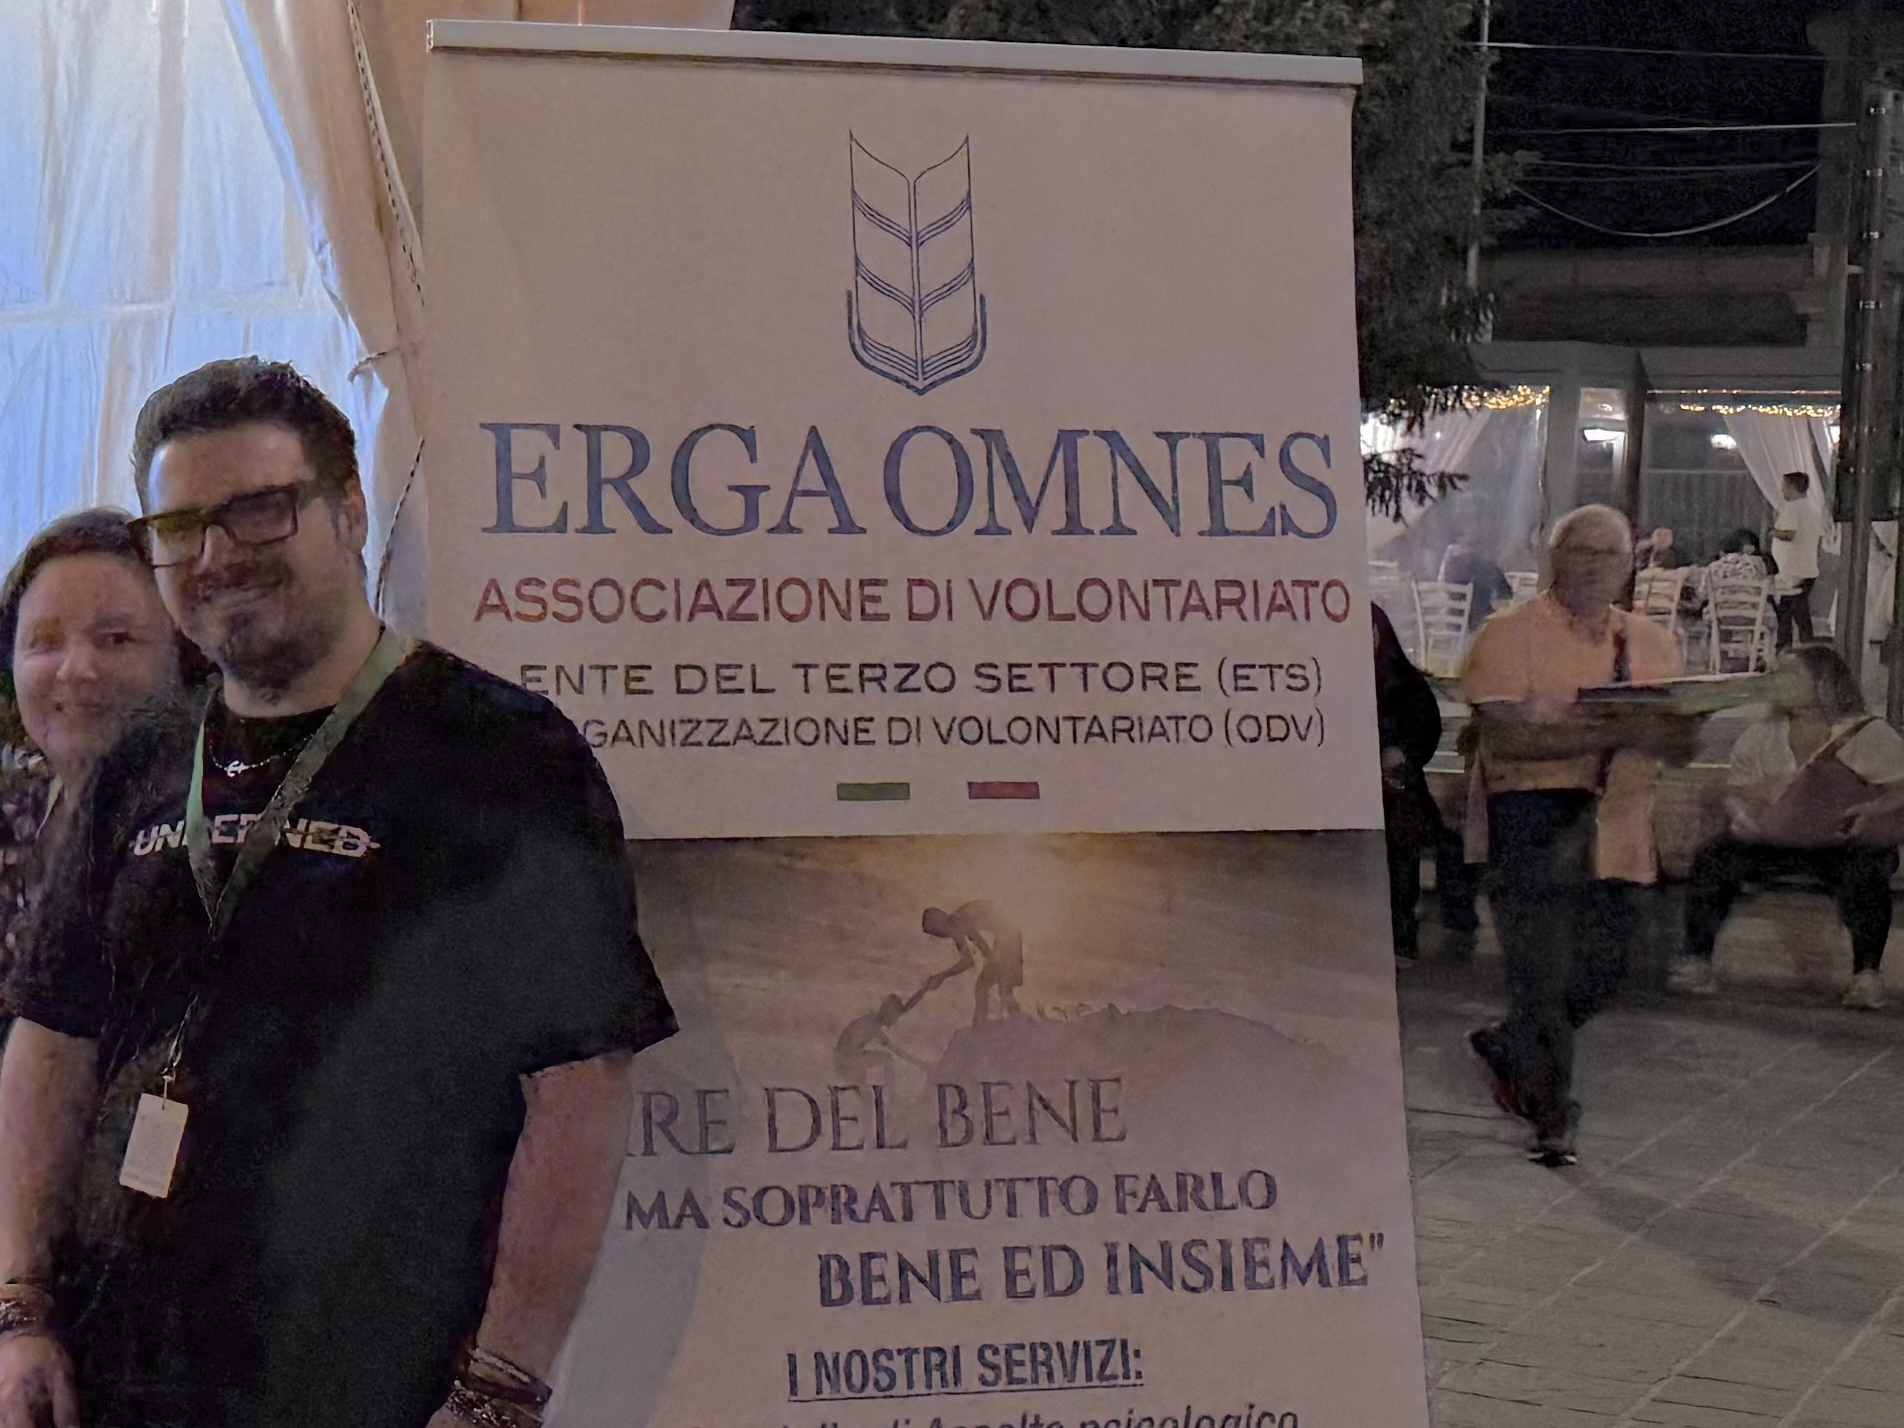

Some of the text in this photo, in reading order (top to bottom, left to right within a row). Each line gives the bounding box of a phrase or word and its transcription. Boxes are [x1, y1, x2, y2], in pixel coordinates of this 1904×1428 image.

[479, 422, 1338, 539] ERGA OMNES
[474, 577, 1350, 625] ASSOCIAZIONE DI VOLONTARIATO
[521, 662, 1322, 698] ENTE DEL TERZO SETTORE (ETS)
[587, 714, 1326, 750] GANIZZAZIONE DI VOLONTARIATO (ODV)
[764, 1077, 1127, 1154] DEL BENE
[627, 1170, 1276, 1232] MA SOPRATTUTTO FARLO
[818, 1250, 981, 1308] BENE
[1004, 1245, 1084, 1300] ED
[815, 1339, 1142, 1397] NOSTRI SERVIZI:
